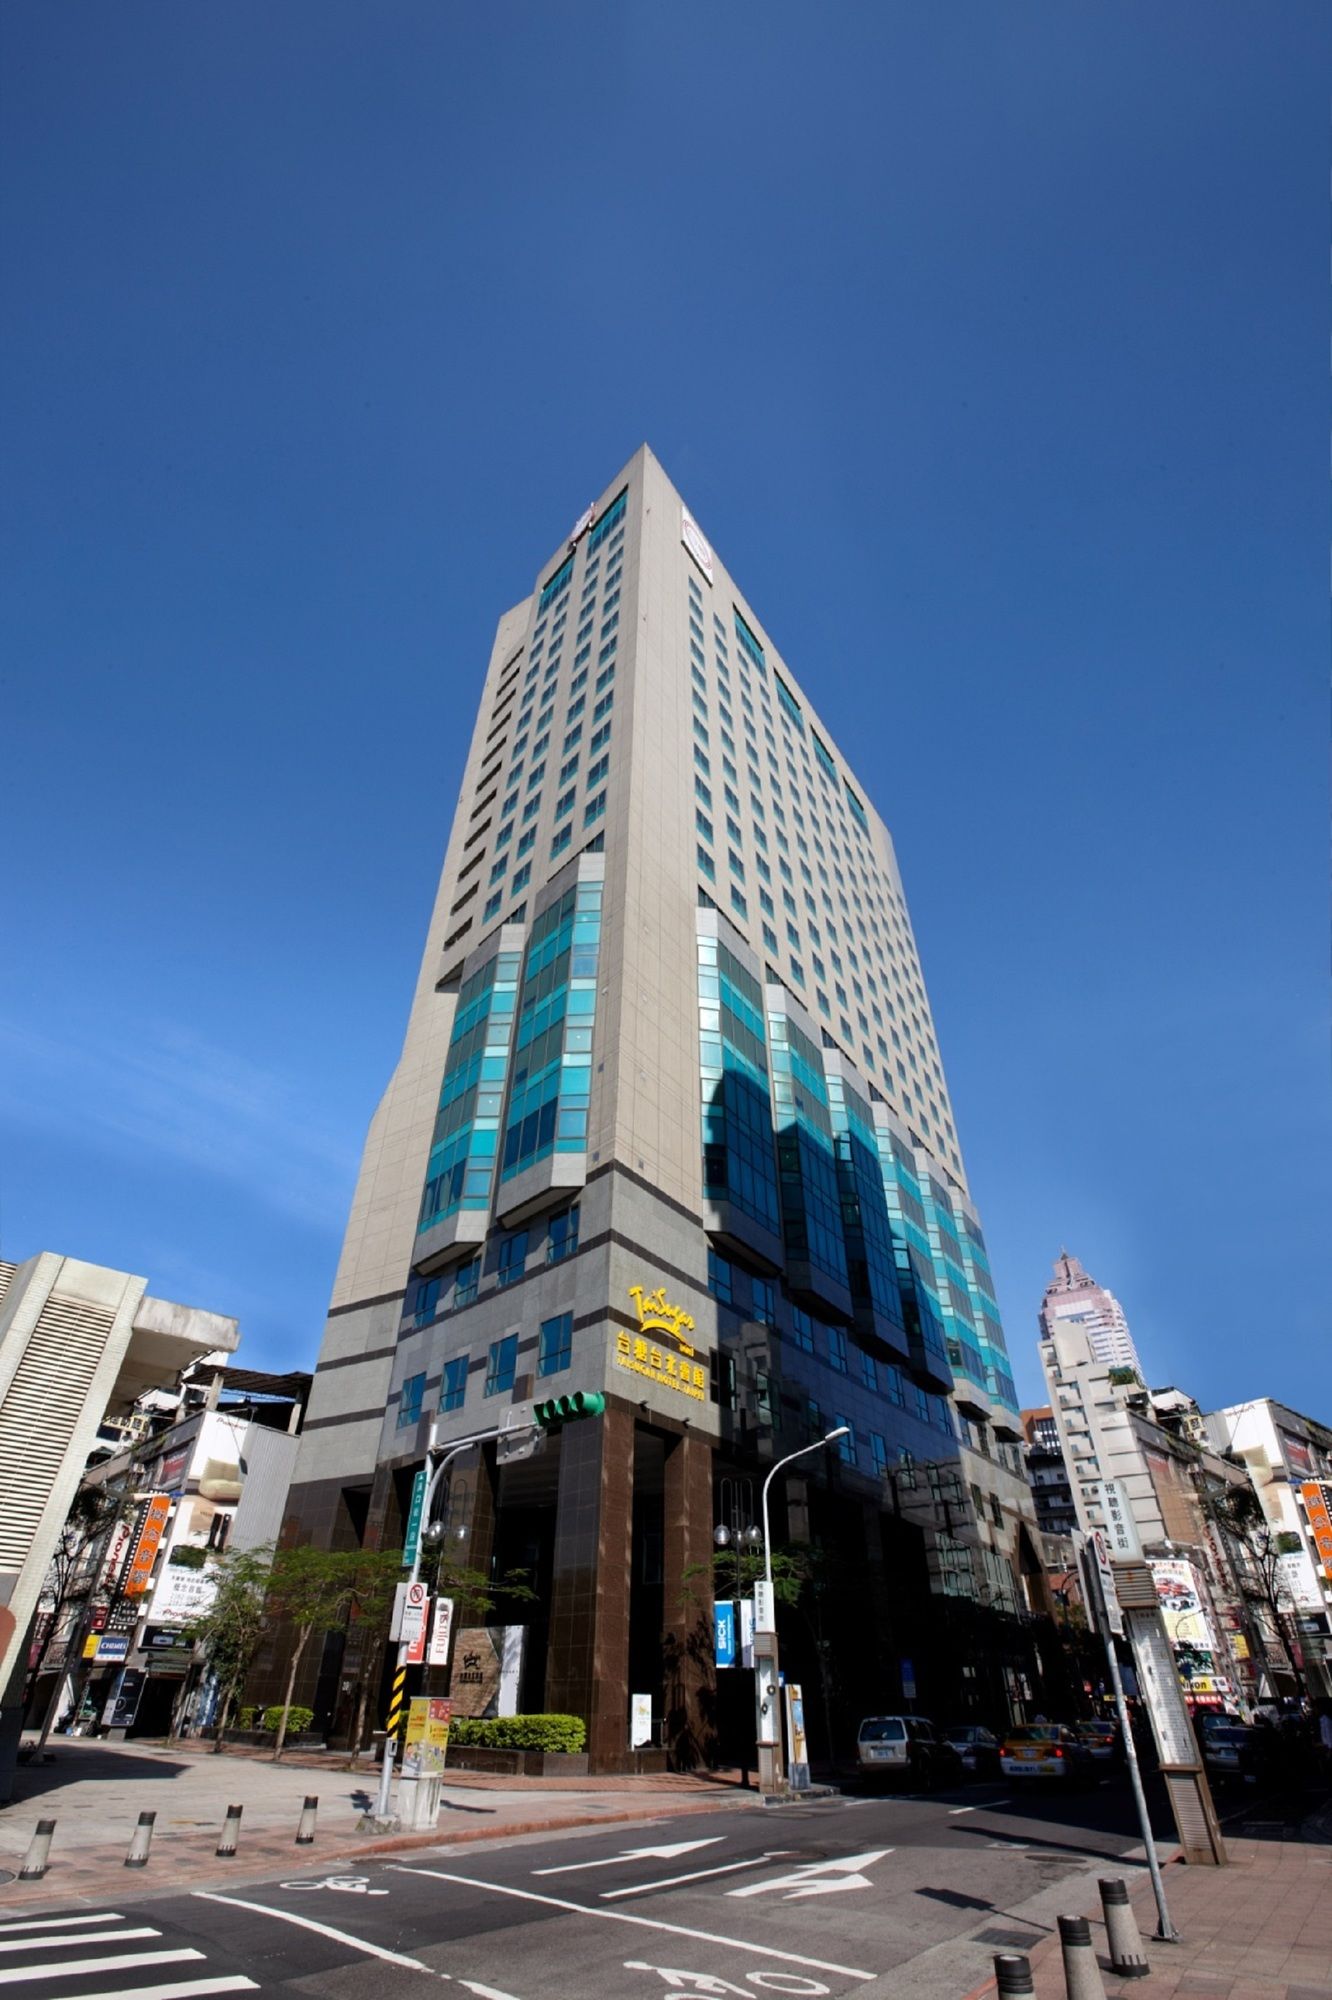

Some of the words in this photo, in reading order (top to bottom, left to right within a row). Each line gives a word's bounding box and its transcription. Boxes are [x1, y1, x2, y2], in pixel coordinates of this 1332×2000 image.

[1104, 1483, 1129, 1550] 視聽影音街
[435, 1609, 450, 1654] FUJITSU
[717, 1619, 727, 1650] SICK
